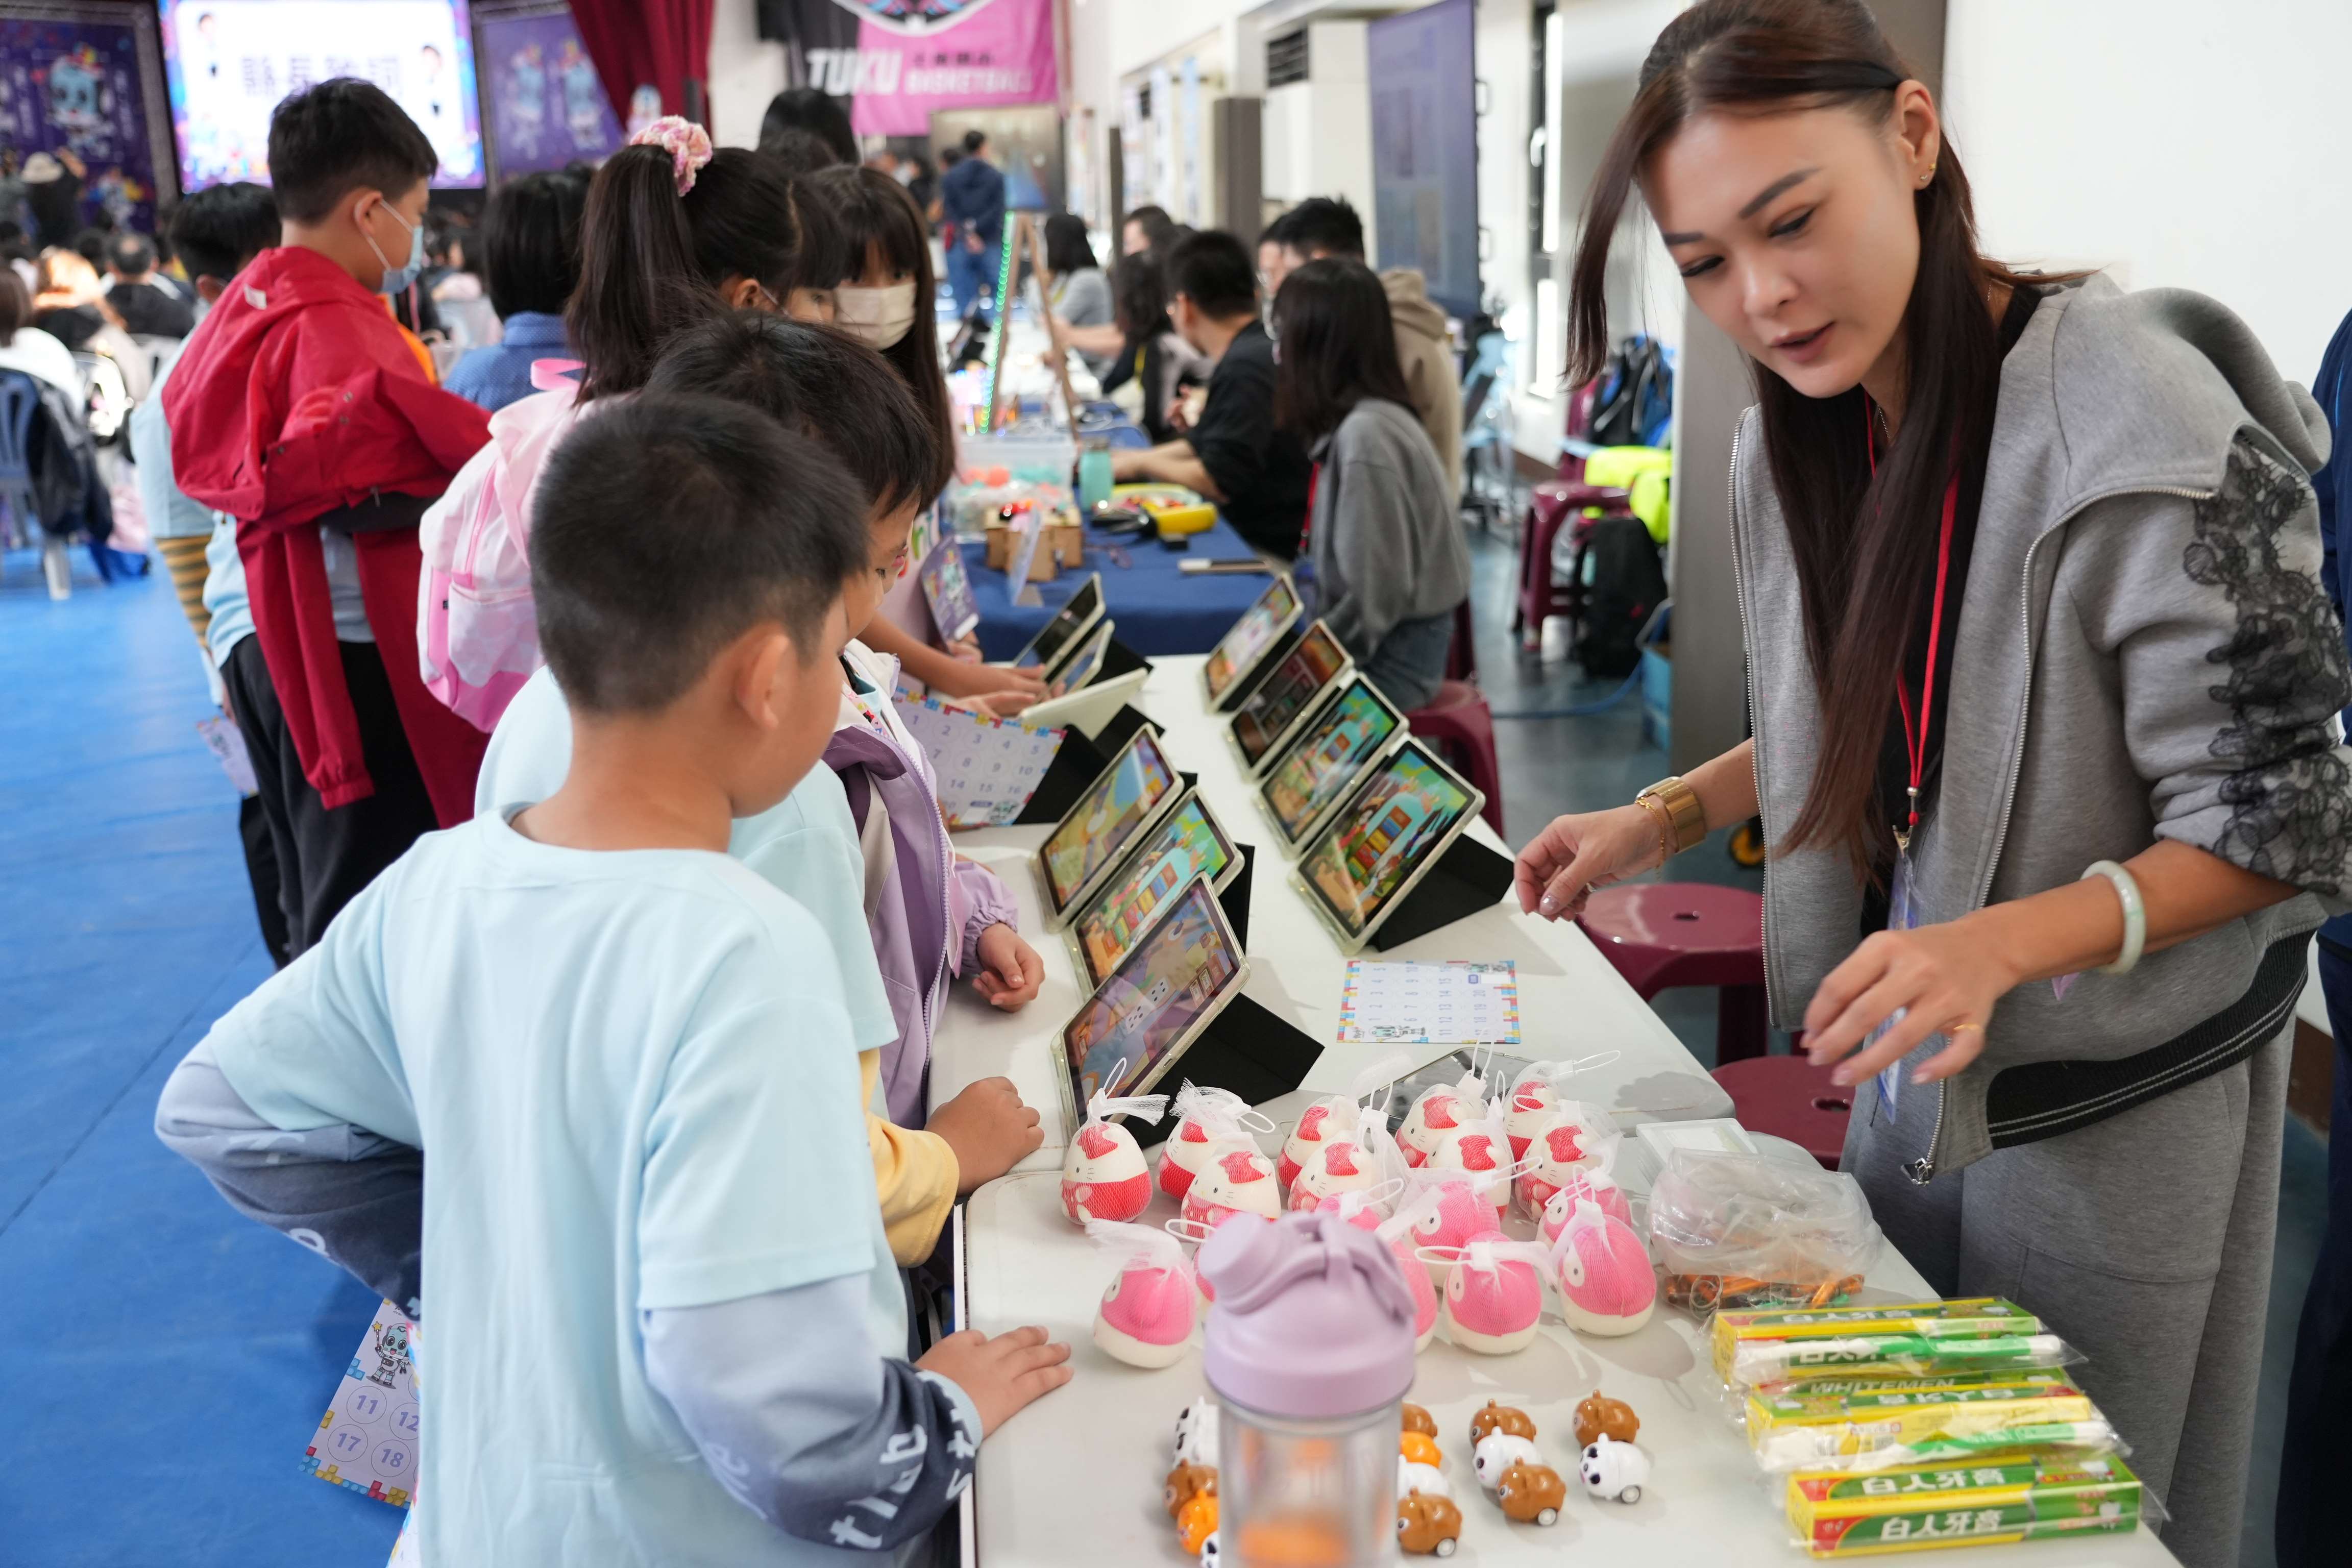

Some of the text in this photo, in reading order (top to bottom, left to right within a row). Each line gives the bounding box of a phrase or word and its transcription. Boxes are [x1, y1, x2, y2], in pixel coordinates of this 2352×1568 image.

[806, 48, 902, 95] TUKU
[904, 68, 1033, 95] BASKETBALL
[913, 715, 919, 725] 1
[942, 725, 951, 737] 2
[973, 734, 982, 744] 3
[1003, 741, 1010, 750] 4
[1031, 745, 1039, 755] 5
[933, 748, 942, 759] 7
[963, 757, 971, 768] 8
[992, 763, 1001, 772] 9
[1019, 766, 1033, 776] 10
[950, 779, 965, 789] 14
[979, 783, 993, 793] 15
[1008, 787, 1021, 795] 16
[357, 1394, 378, 1415] 11
[399, 1411, 420, 1432] 12
[337, 1433, 361, 1452] 17
[381, 1449, 404, 1468] 18
[1861, 1467, 2005, 1496] 白人牙膏
[1880, 1509, 2004, 1541] 白人牙膏
